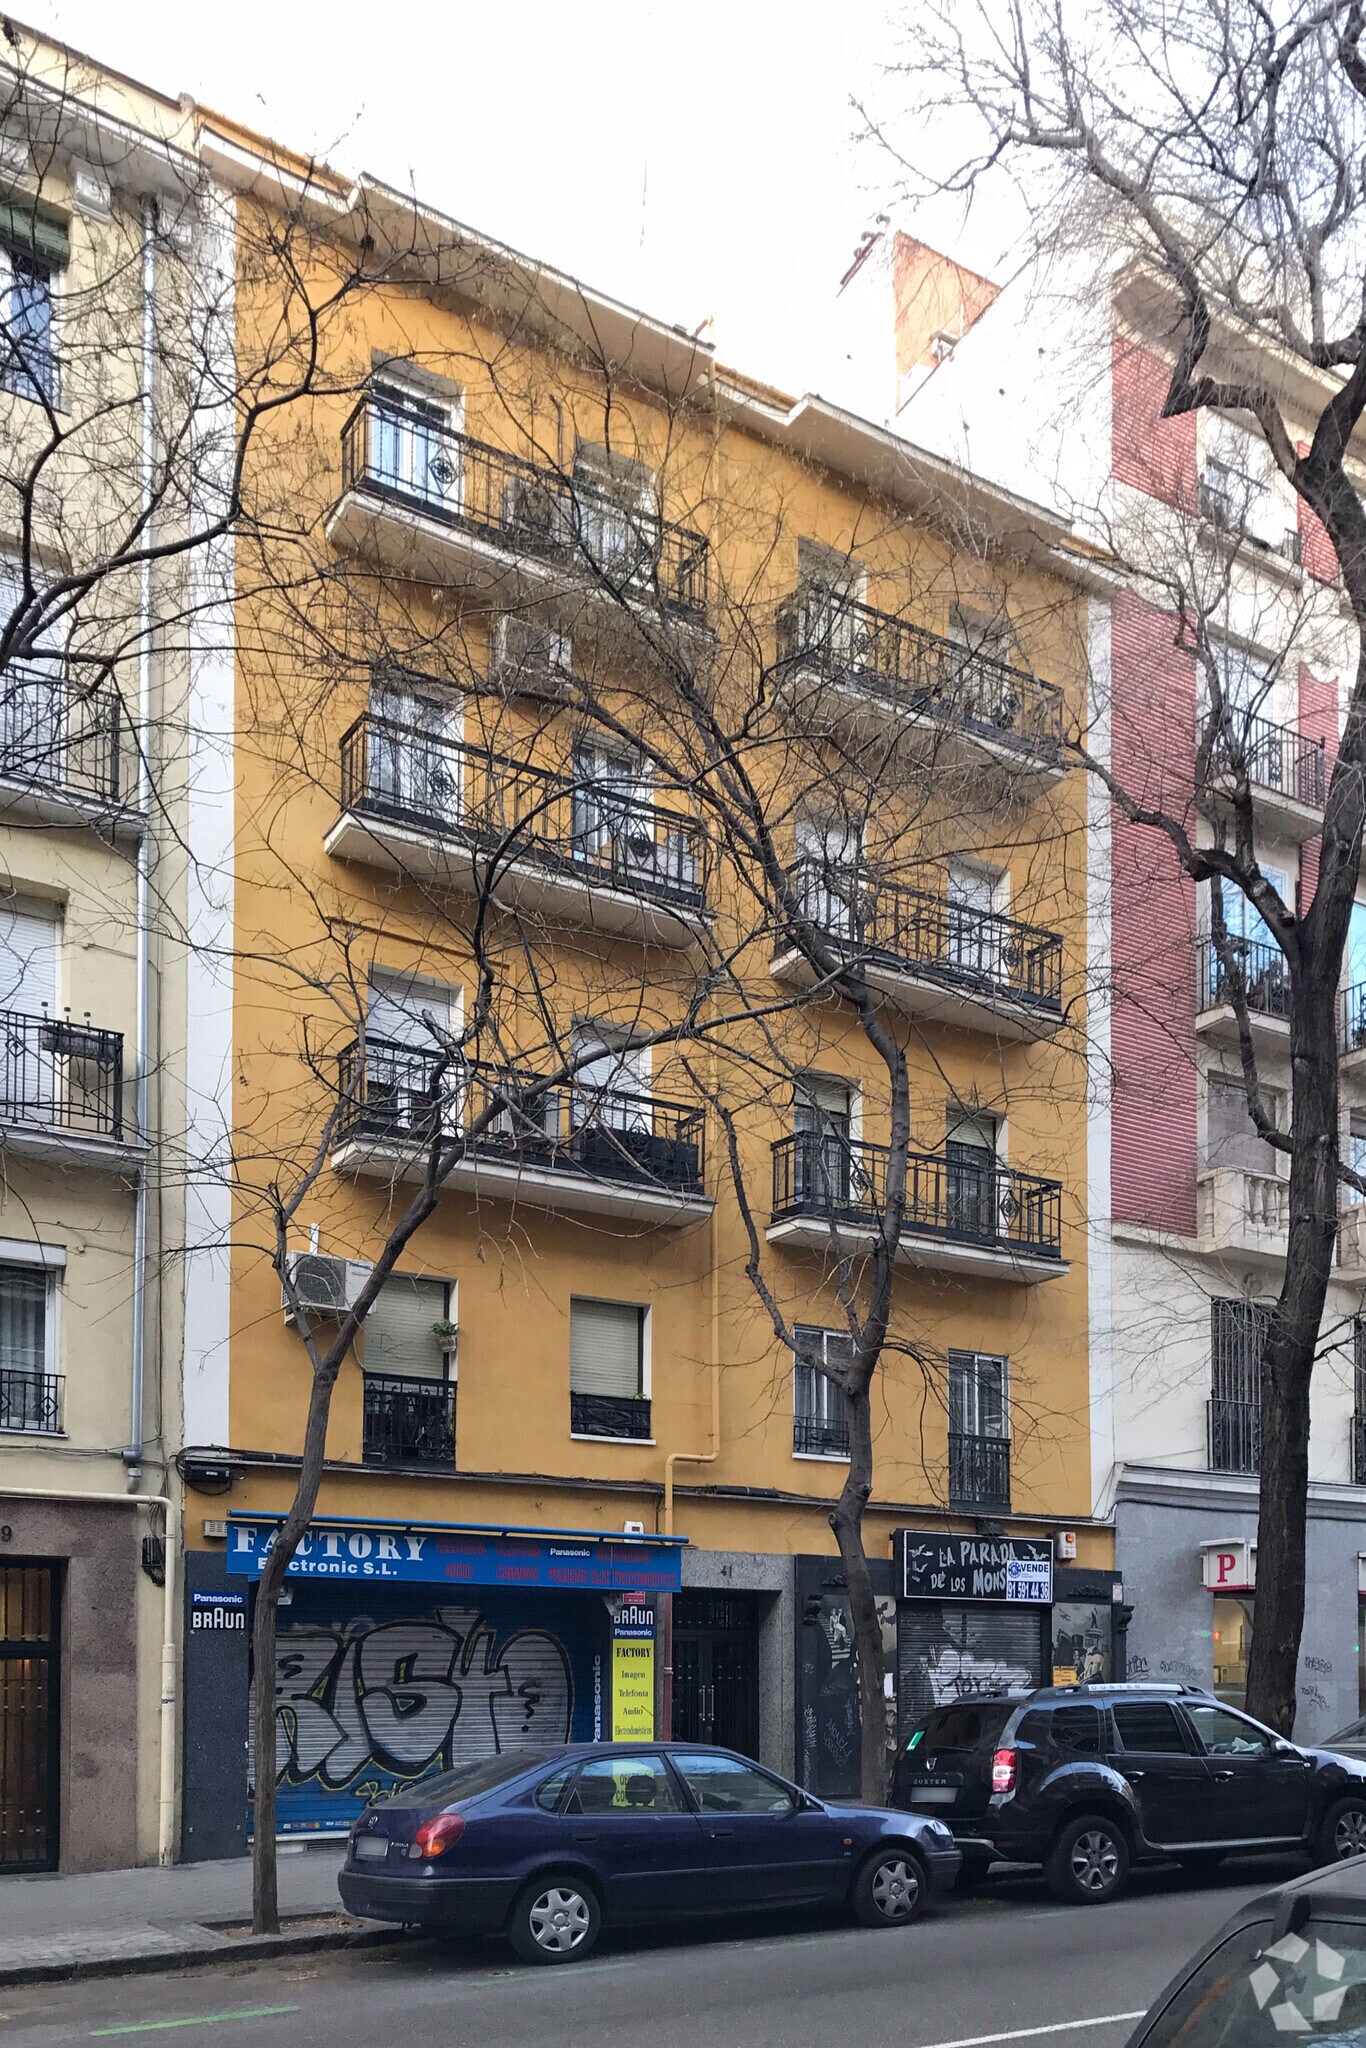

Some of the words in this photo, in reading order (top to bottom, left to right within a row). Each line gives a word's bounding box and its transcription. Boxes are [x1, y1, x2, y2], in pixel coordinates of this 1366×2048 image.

[233, 1526, 427, 1561] FACTORY
[550, 1547, 591, 1557] Panasonic
[939, 1546, 956, 1567] LA
[960, 1541, 1018, 1566] PARADA
[257, 1557, 358, 1573] Ectronic
[363, 1562, 398, 1575] S.L.
[445, 1563, 474, 1579] AUDIO
[1020, 1563, 1049, 1573] VENDE
[1217, 1553, 1236, 1583] P
[930, 1571, 946, 1589] DE
[950, 1576, 966, 1592] LOS
[1008, 1581, 1016, 1599] 91
[1018, 1581, 1029, 1599] 591
[1030, 1582, 1039, 1599] 44
[193, 1593, 243, 1603] Panasonic
[192, 1607, 245, 1629] BRAUN
[613, 1605, 654, 1625] BRAUN
[614, 1628, 653, 1636] Panasonic
[616, 1647, 651, 1658] FACTORY
[621, 1670, 645, 1680] Imagen
[623, 1707, 644, 1715] Audio
